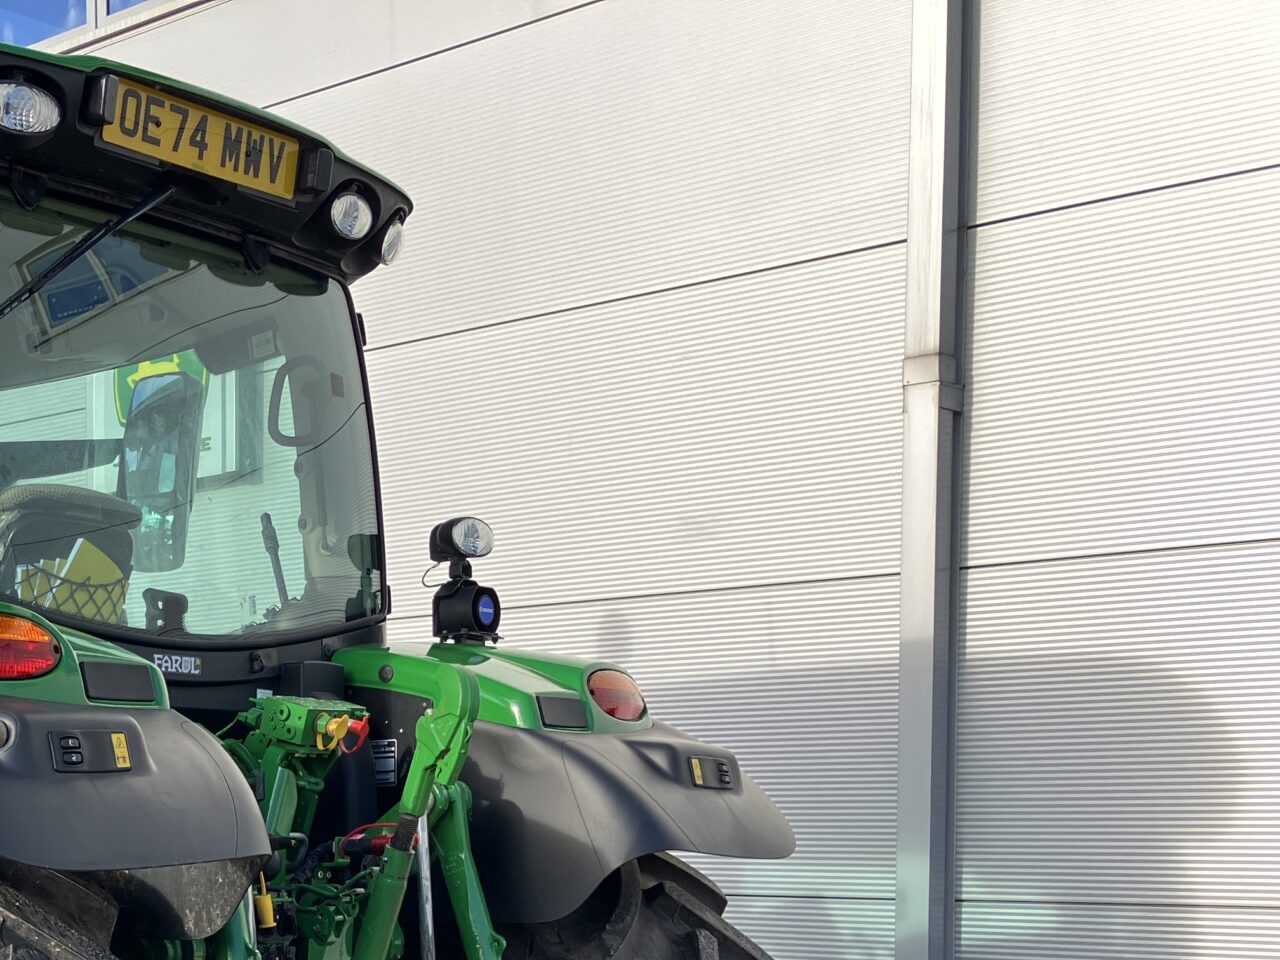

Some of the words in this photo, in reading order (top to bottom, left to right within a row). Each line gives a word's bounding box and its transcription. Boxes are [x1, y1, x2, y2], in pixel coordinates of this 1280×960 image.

[119, 87, 208, 160] OE74
[220, 121, 286, 184] MWV
[153, 654, 200, 674] FAROL
